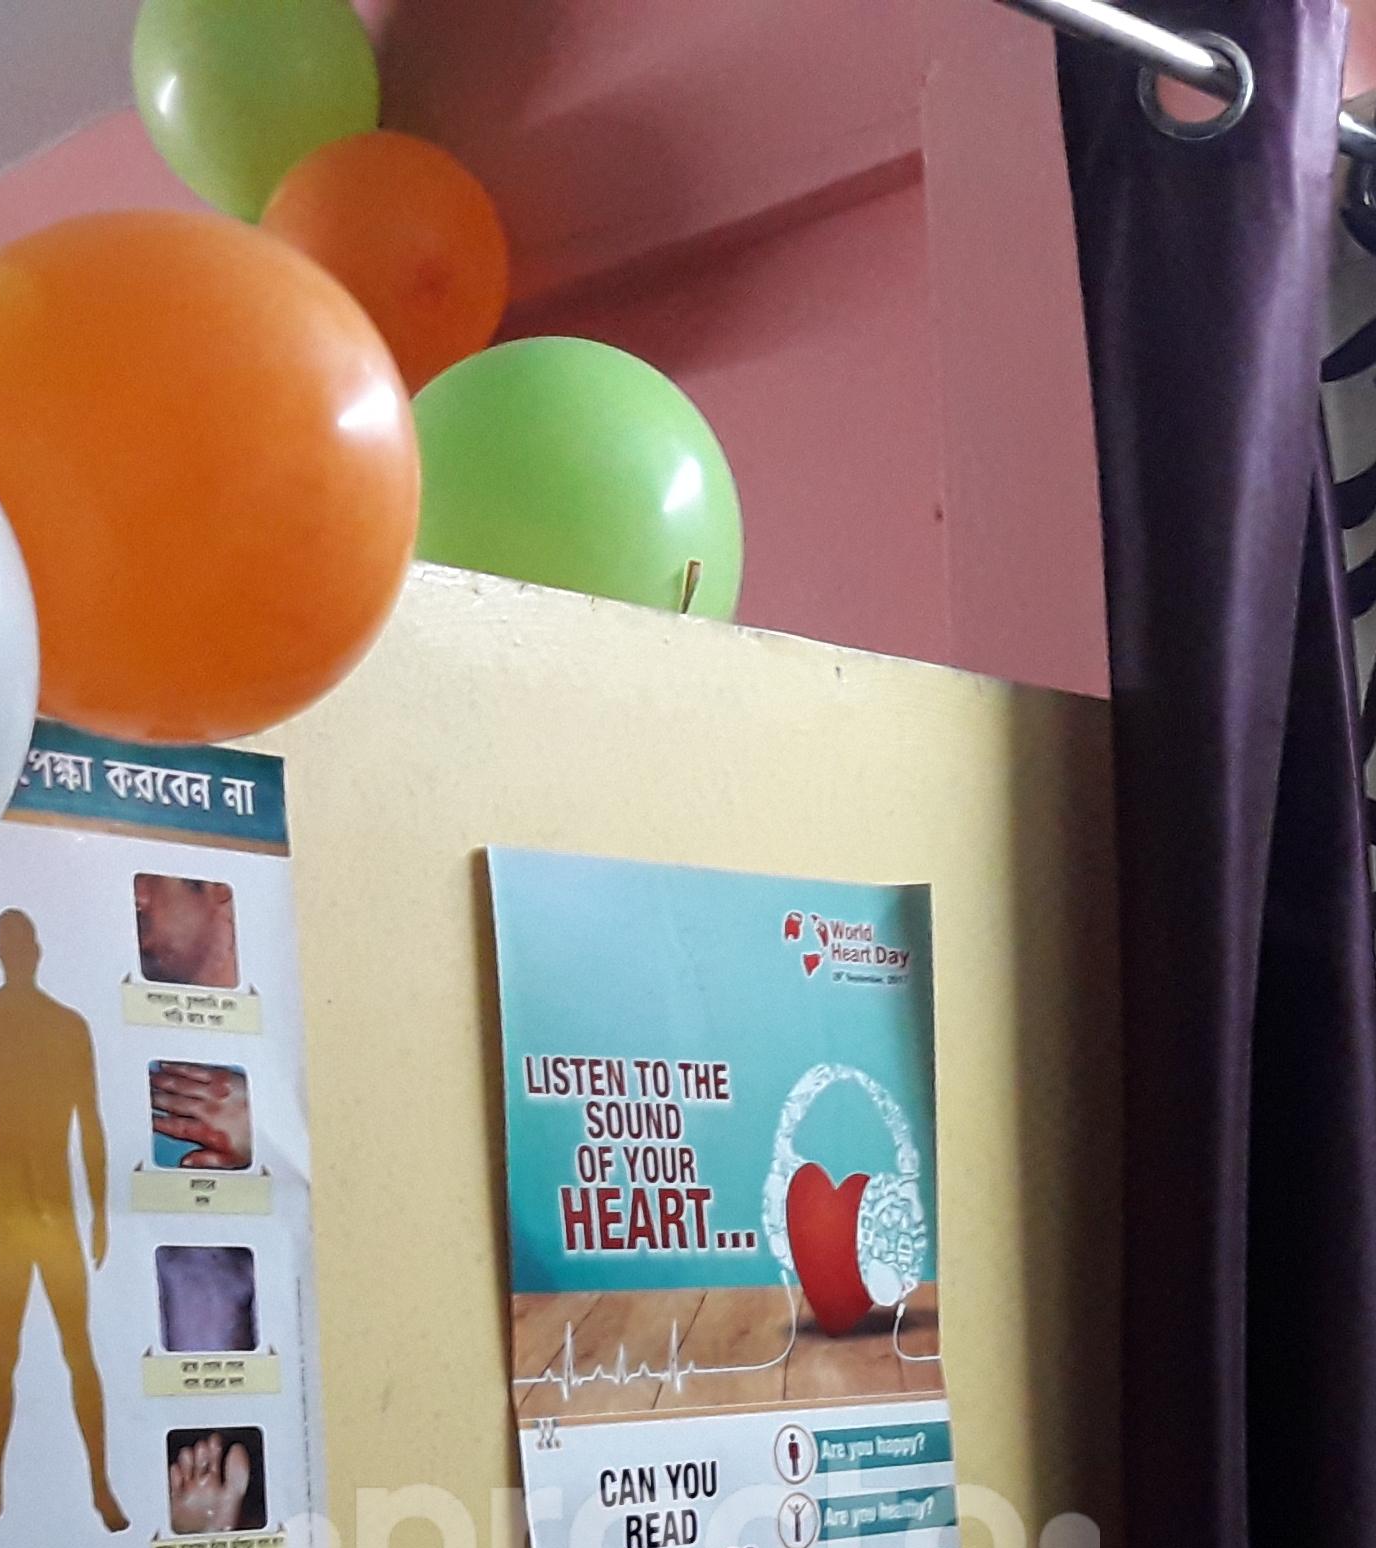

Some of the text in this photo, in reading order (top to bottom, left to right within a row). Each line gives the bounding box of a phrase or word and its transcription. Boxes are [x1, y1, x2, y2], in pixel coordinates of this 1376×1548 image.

[104, 760, 212, 810] করবেন
[221, 778, 256, 815] না
[831, 921, 873, 941] World
[831, 944, 910, 968] Heart Day
[525, 1055, 730, 1100] LISTEN TO THE
[586, 1101, 682, 1140] SOUND
[578, 1145, 697, 1184] OF YOUR
[560, 1187, 756, 1250] HEART...
[821, 1439, 845, 1460] Are
[600, 1460, 718, 1507] CAN YOU
